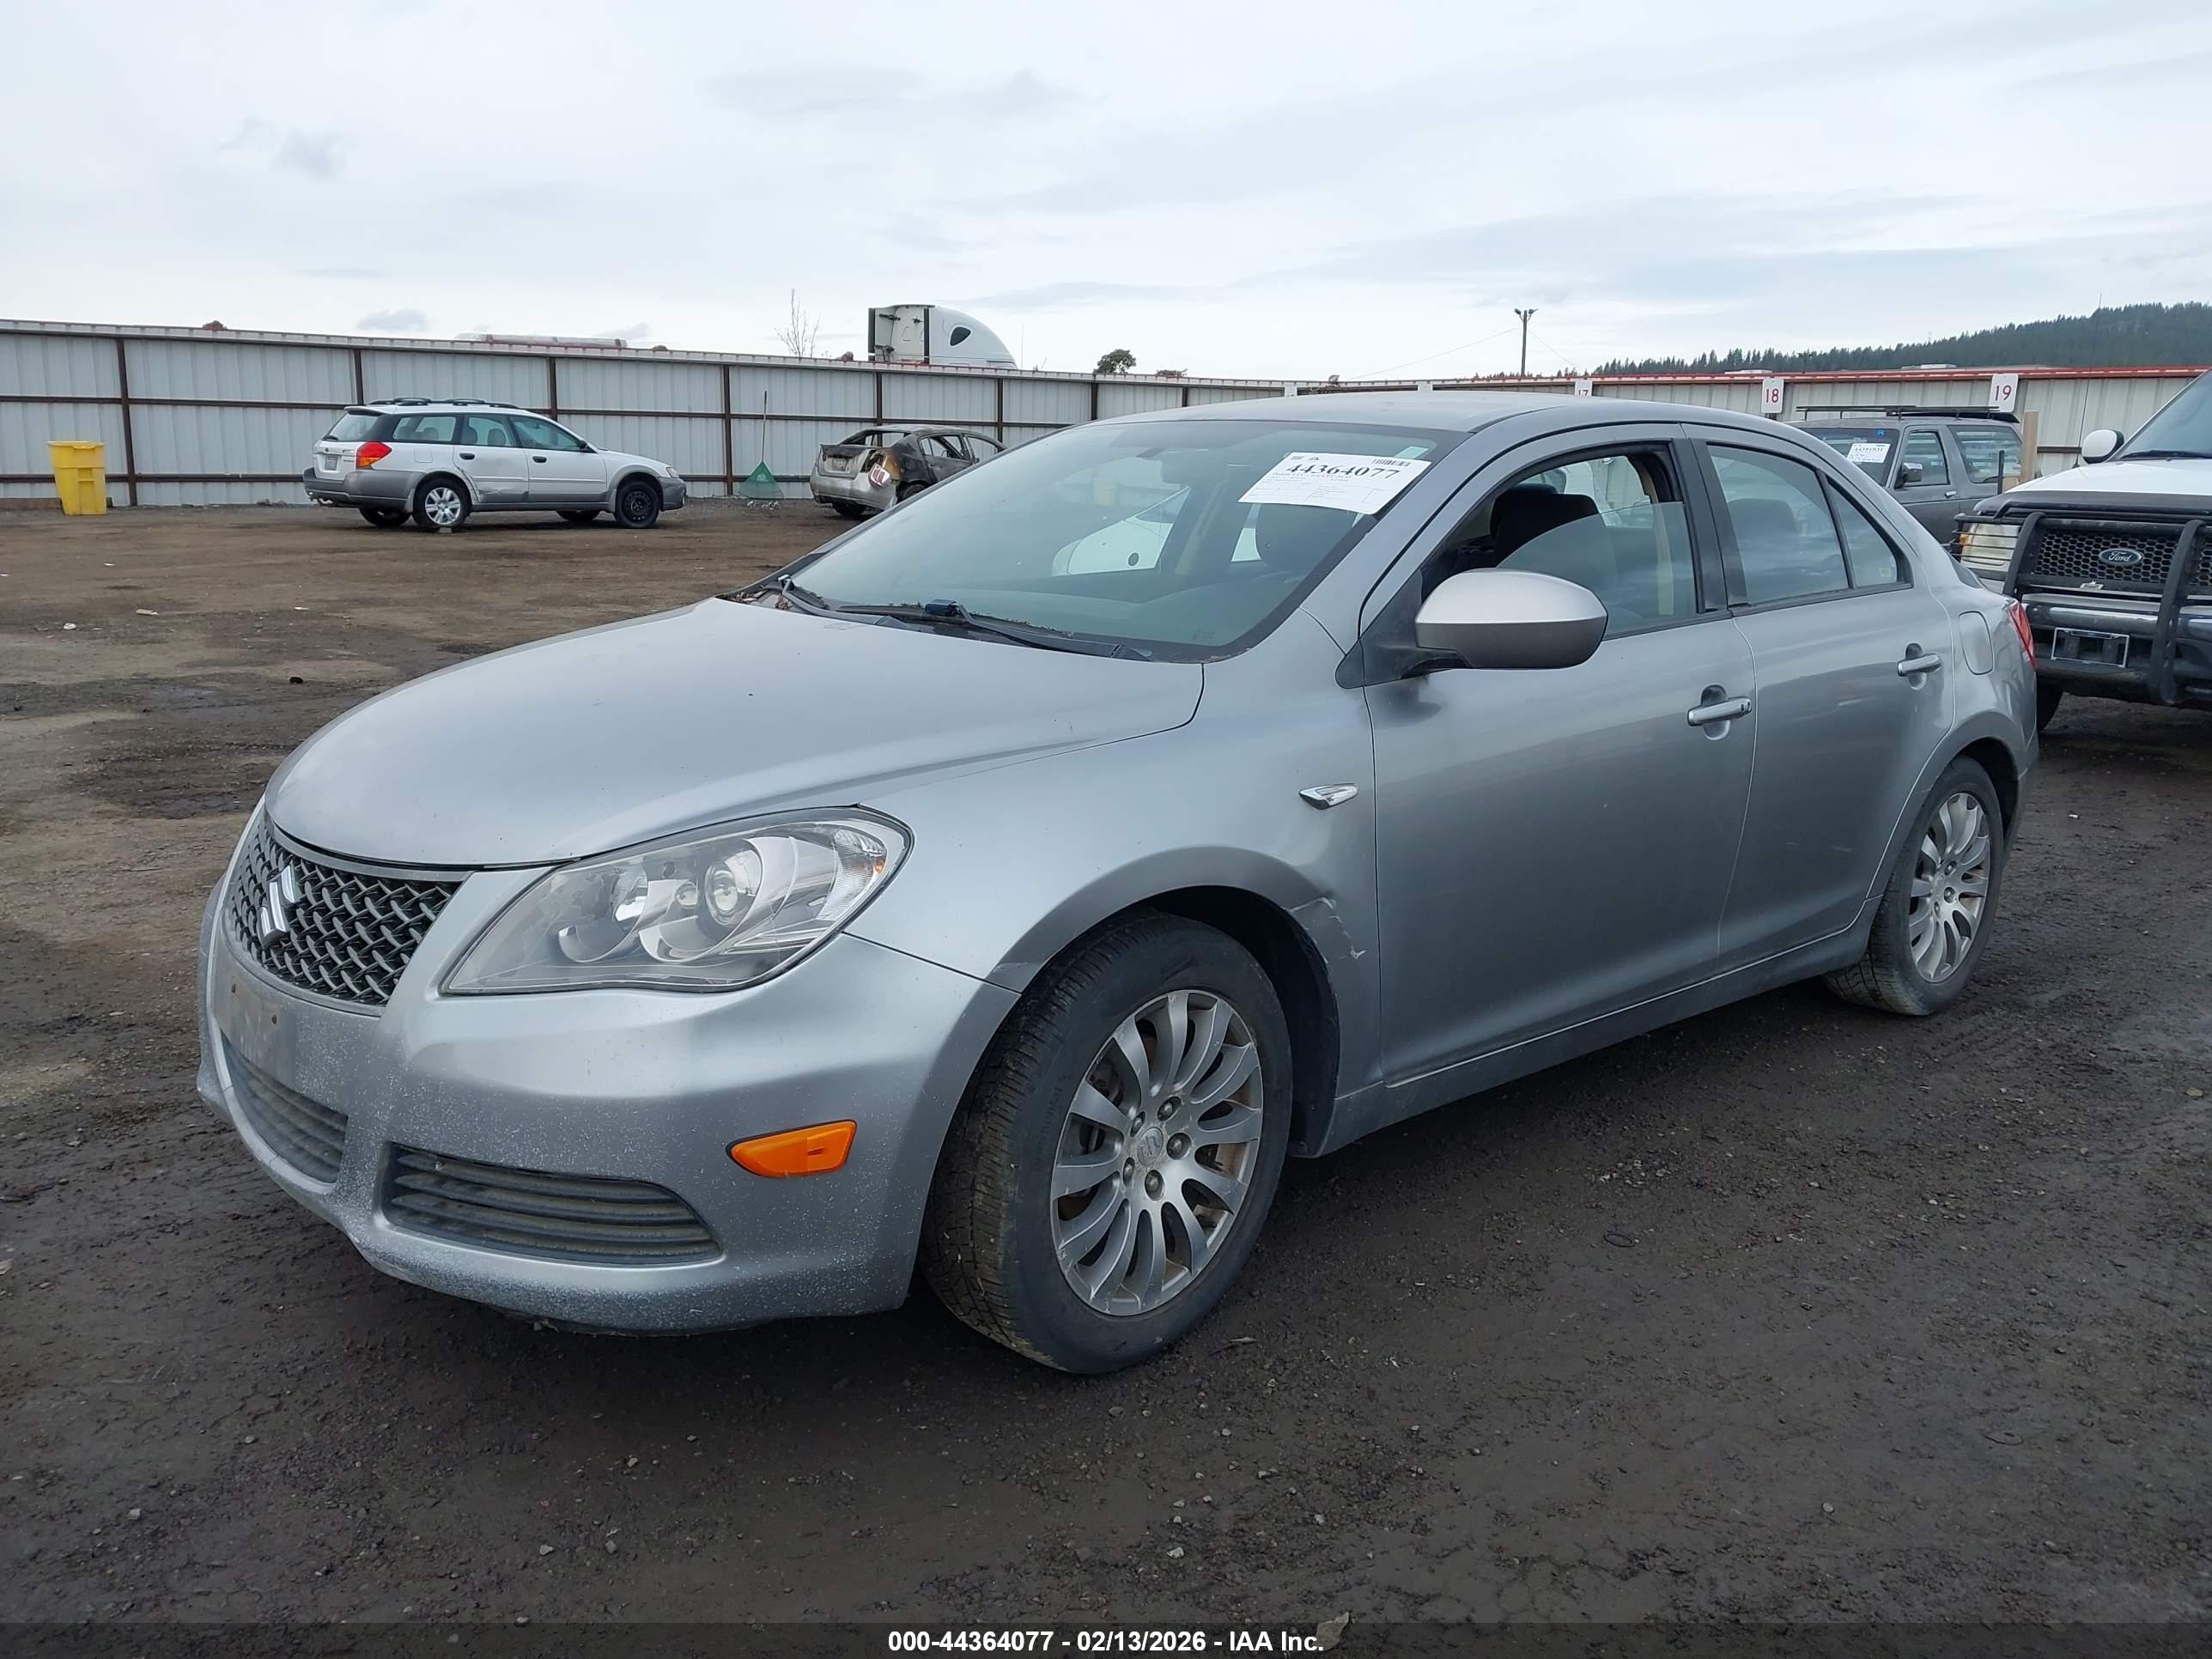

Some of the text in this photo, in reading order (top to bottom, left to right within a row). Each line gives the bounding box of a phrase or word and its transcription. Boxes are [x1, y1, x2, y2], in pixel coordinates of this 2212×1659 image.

[1766, 388, 1779, 403] 18
[1995, 385, 2012, 401] 19
[1285, 464, 1401, 479] 44364077
[2108, 550, 2133, 562] Ford
